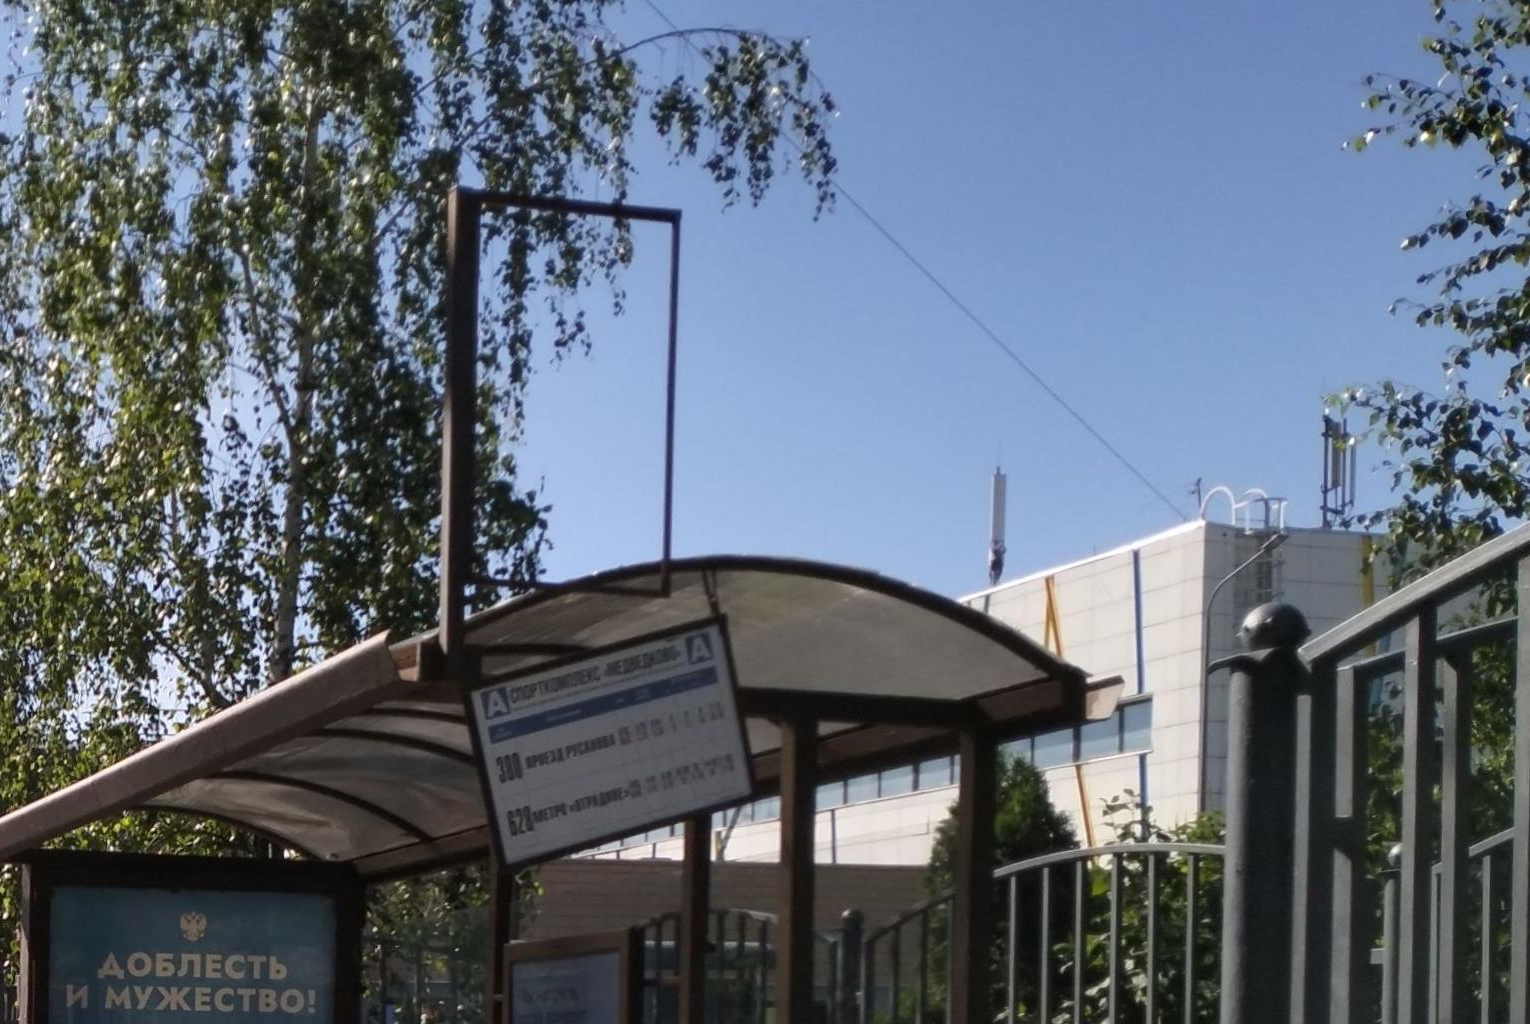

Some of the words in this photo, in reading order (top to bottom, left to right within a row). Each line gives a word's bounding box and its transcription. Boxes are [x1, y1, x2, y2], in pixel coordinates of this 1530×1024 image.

[97, 951, 288, 980] ДОБЛЕСТЬ
[66, 984, 89, 1009] И
[105, 985, 317, 1013] МУЖЕСТВО!
